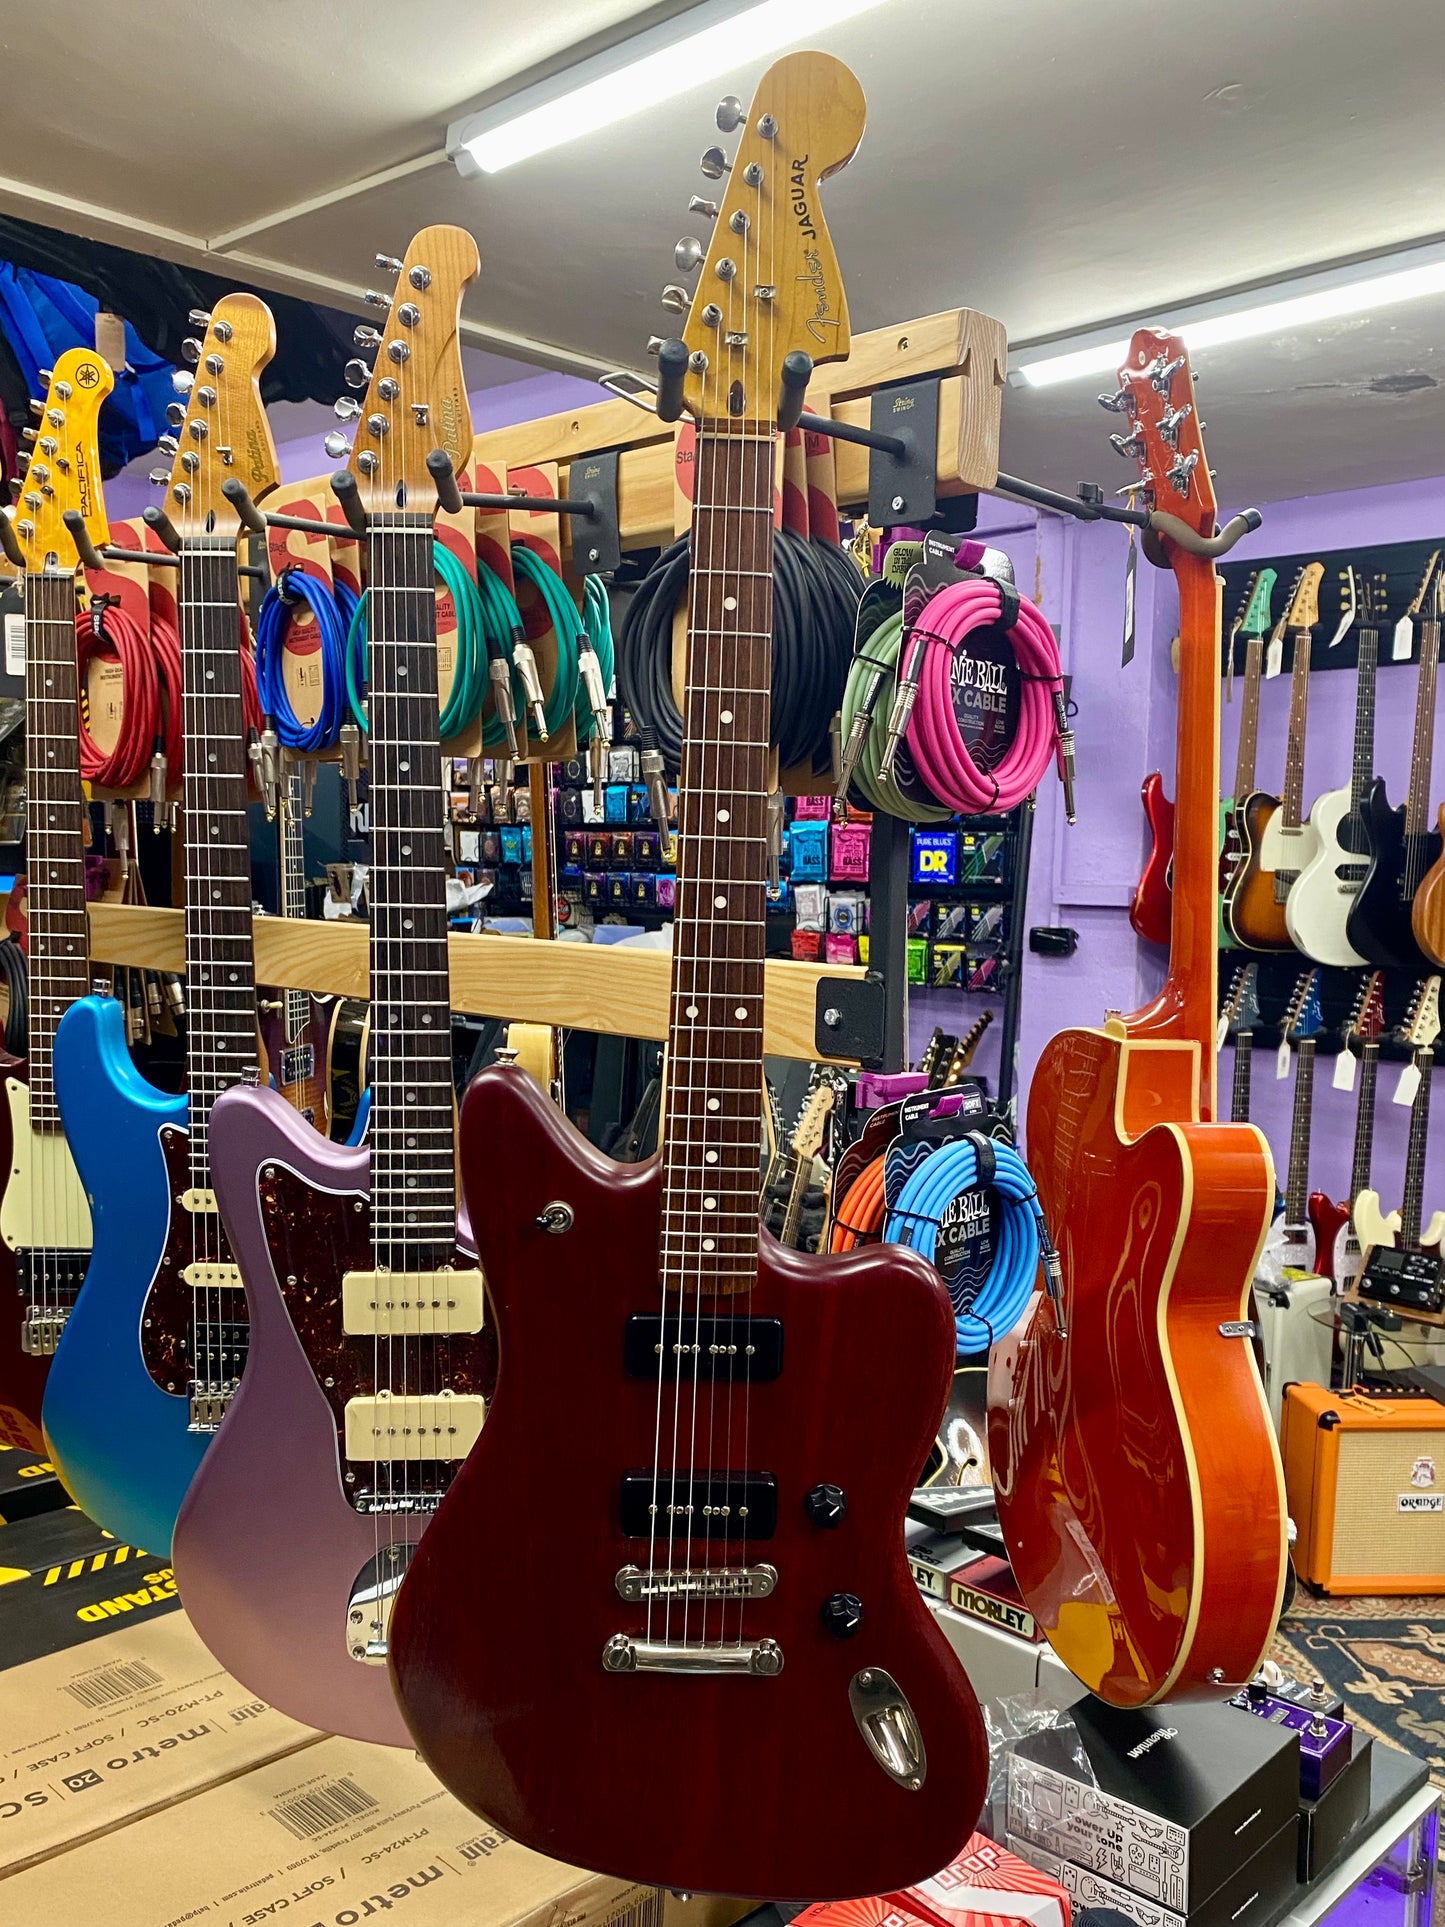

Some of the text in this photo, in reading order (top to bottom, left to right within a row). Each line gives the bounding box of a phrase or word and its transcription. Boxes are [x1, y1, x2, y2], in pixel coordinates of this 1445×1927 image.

[791, 154, 841, 343] Fender JAGUAR
[441, 397, 462, 458] Patina
[246, 429, 269, 482] Patina
[676, 450, 694, 464] Sta
[75, 440, 89, 518] PACIFICA
[893, 548, 913, 557] GLOW
[950, 649, 1007, 695] NIE BALL
[964, 689, 1007, 714] CABLE
[916, 838, 952, 846] PURE BLUES
[919, 850, 948, 872] DR
[904, 1103, 930, 1113] INSTRUMENT
[904, 1113, 919, 1121] CABLE
[957, 1189, 990, 1223] BALL
[949, 1217, 990, 1244] CABLE
[1401, 1498, 1442, 1509] ORANGE
[910, 1564, 935, 1589] LEY
[958, 1587, 1026, 1631] MORLEY
[137, 1690, 224, 1728] PT-M20-SC
[75, 1734, 114, 1755] SOFT
[106, 1724, 212, 1770] metro
[26, 1751, 70, 1772] CASE
[68, 1771, 99, 1789] 20
[361, 1827, 430, 1865] PT-M24-SC
[1066, 1821, 1123, 1852] your tone
[1107, 1828, 1123, 1843] Up
[291, 1875, 335, 1902] SOFT
[335, 1864, 444, 1926] metro
[242, 1898, 290, 1926] CASE
